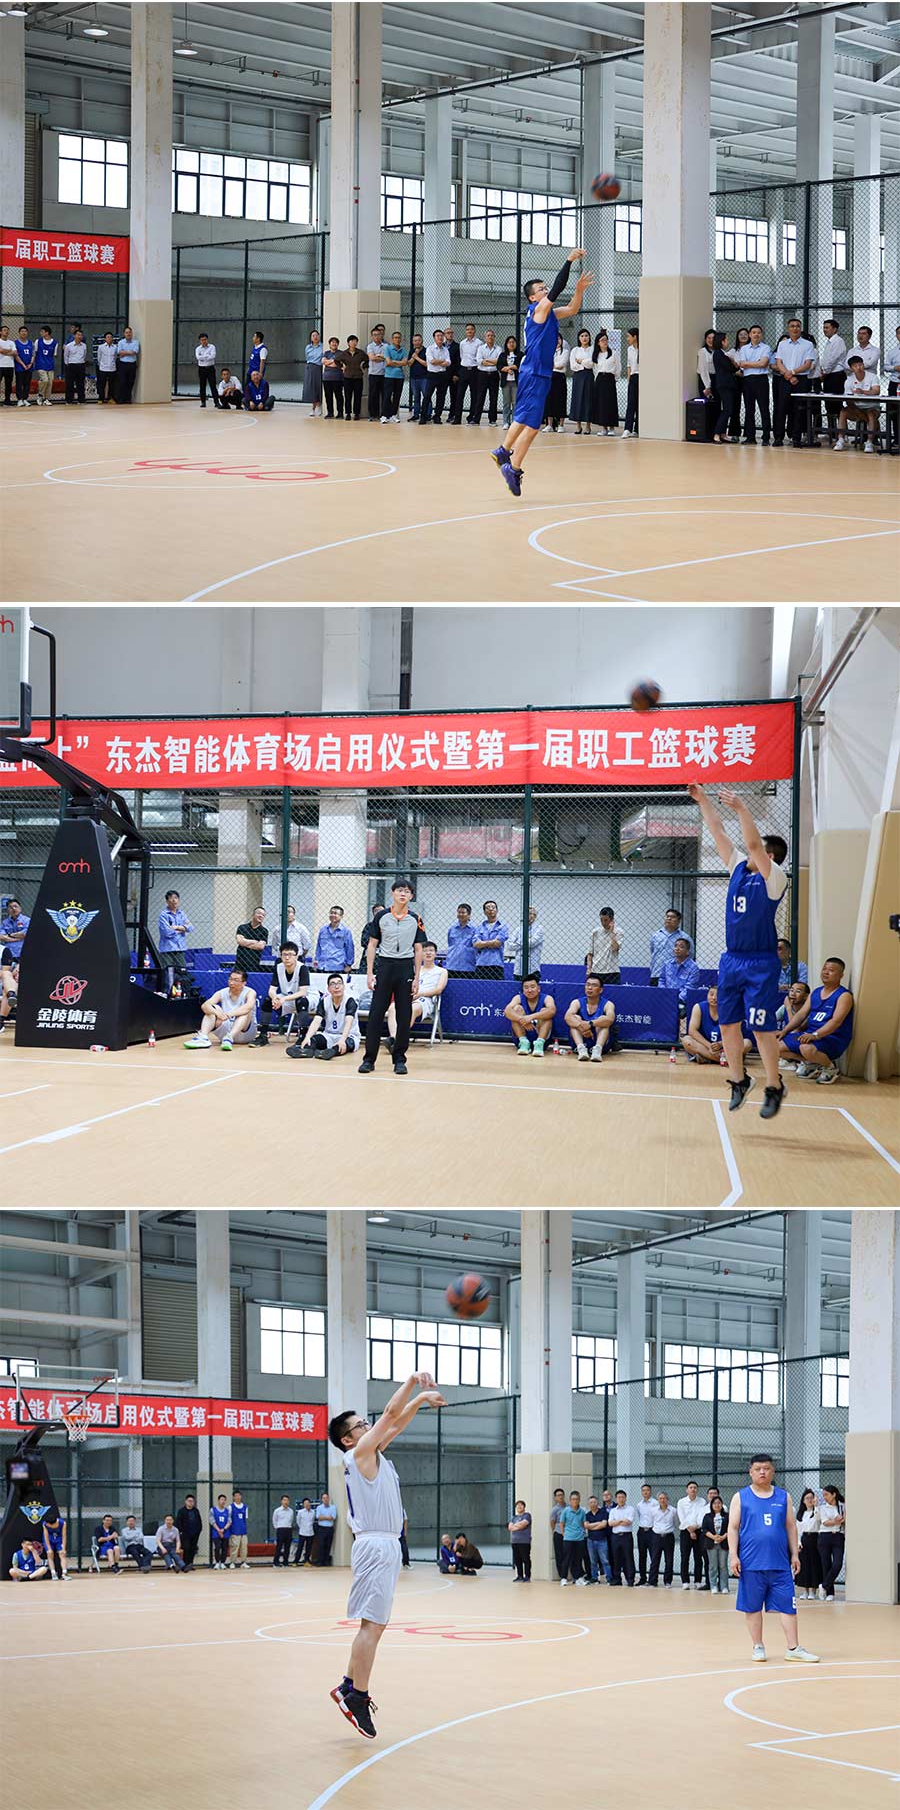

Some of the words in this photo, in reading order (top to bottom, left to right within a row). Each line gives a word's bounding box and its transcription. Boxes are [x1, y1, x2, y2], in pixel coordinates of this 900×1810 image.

[0, 238, 115, 265] 一届职工篮球赛
[106, 723, 757, 774] 东杰智能体育场启用仪式暨第一届职工篮球赛
[733, 895, 747, 913] 13
[37, 1008, 98, 1024] 金陵体育
[749, 1007, 766, 1026] 13
[813, 1011, 828, 1022] 10
[66, 1023, 95, 1031] SPORTS
[710, 1031, 718, 1042] 5
[763, 1513, 772, 1526] 5
